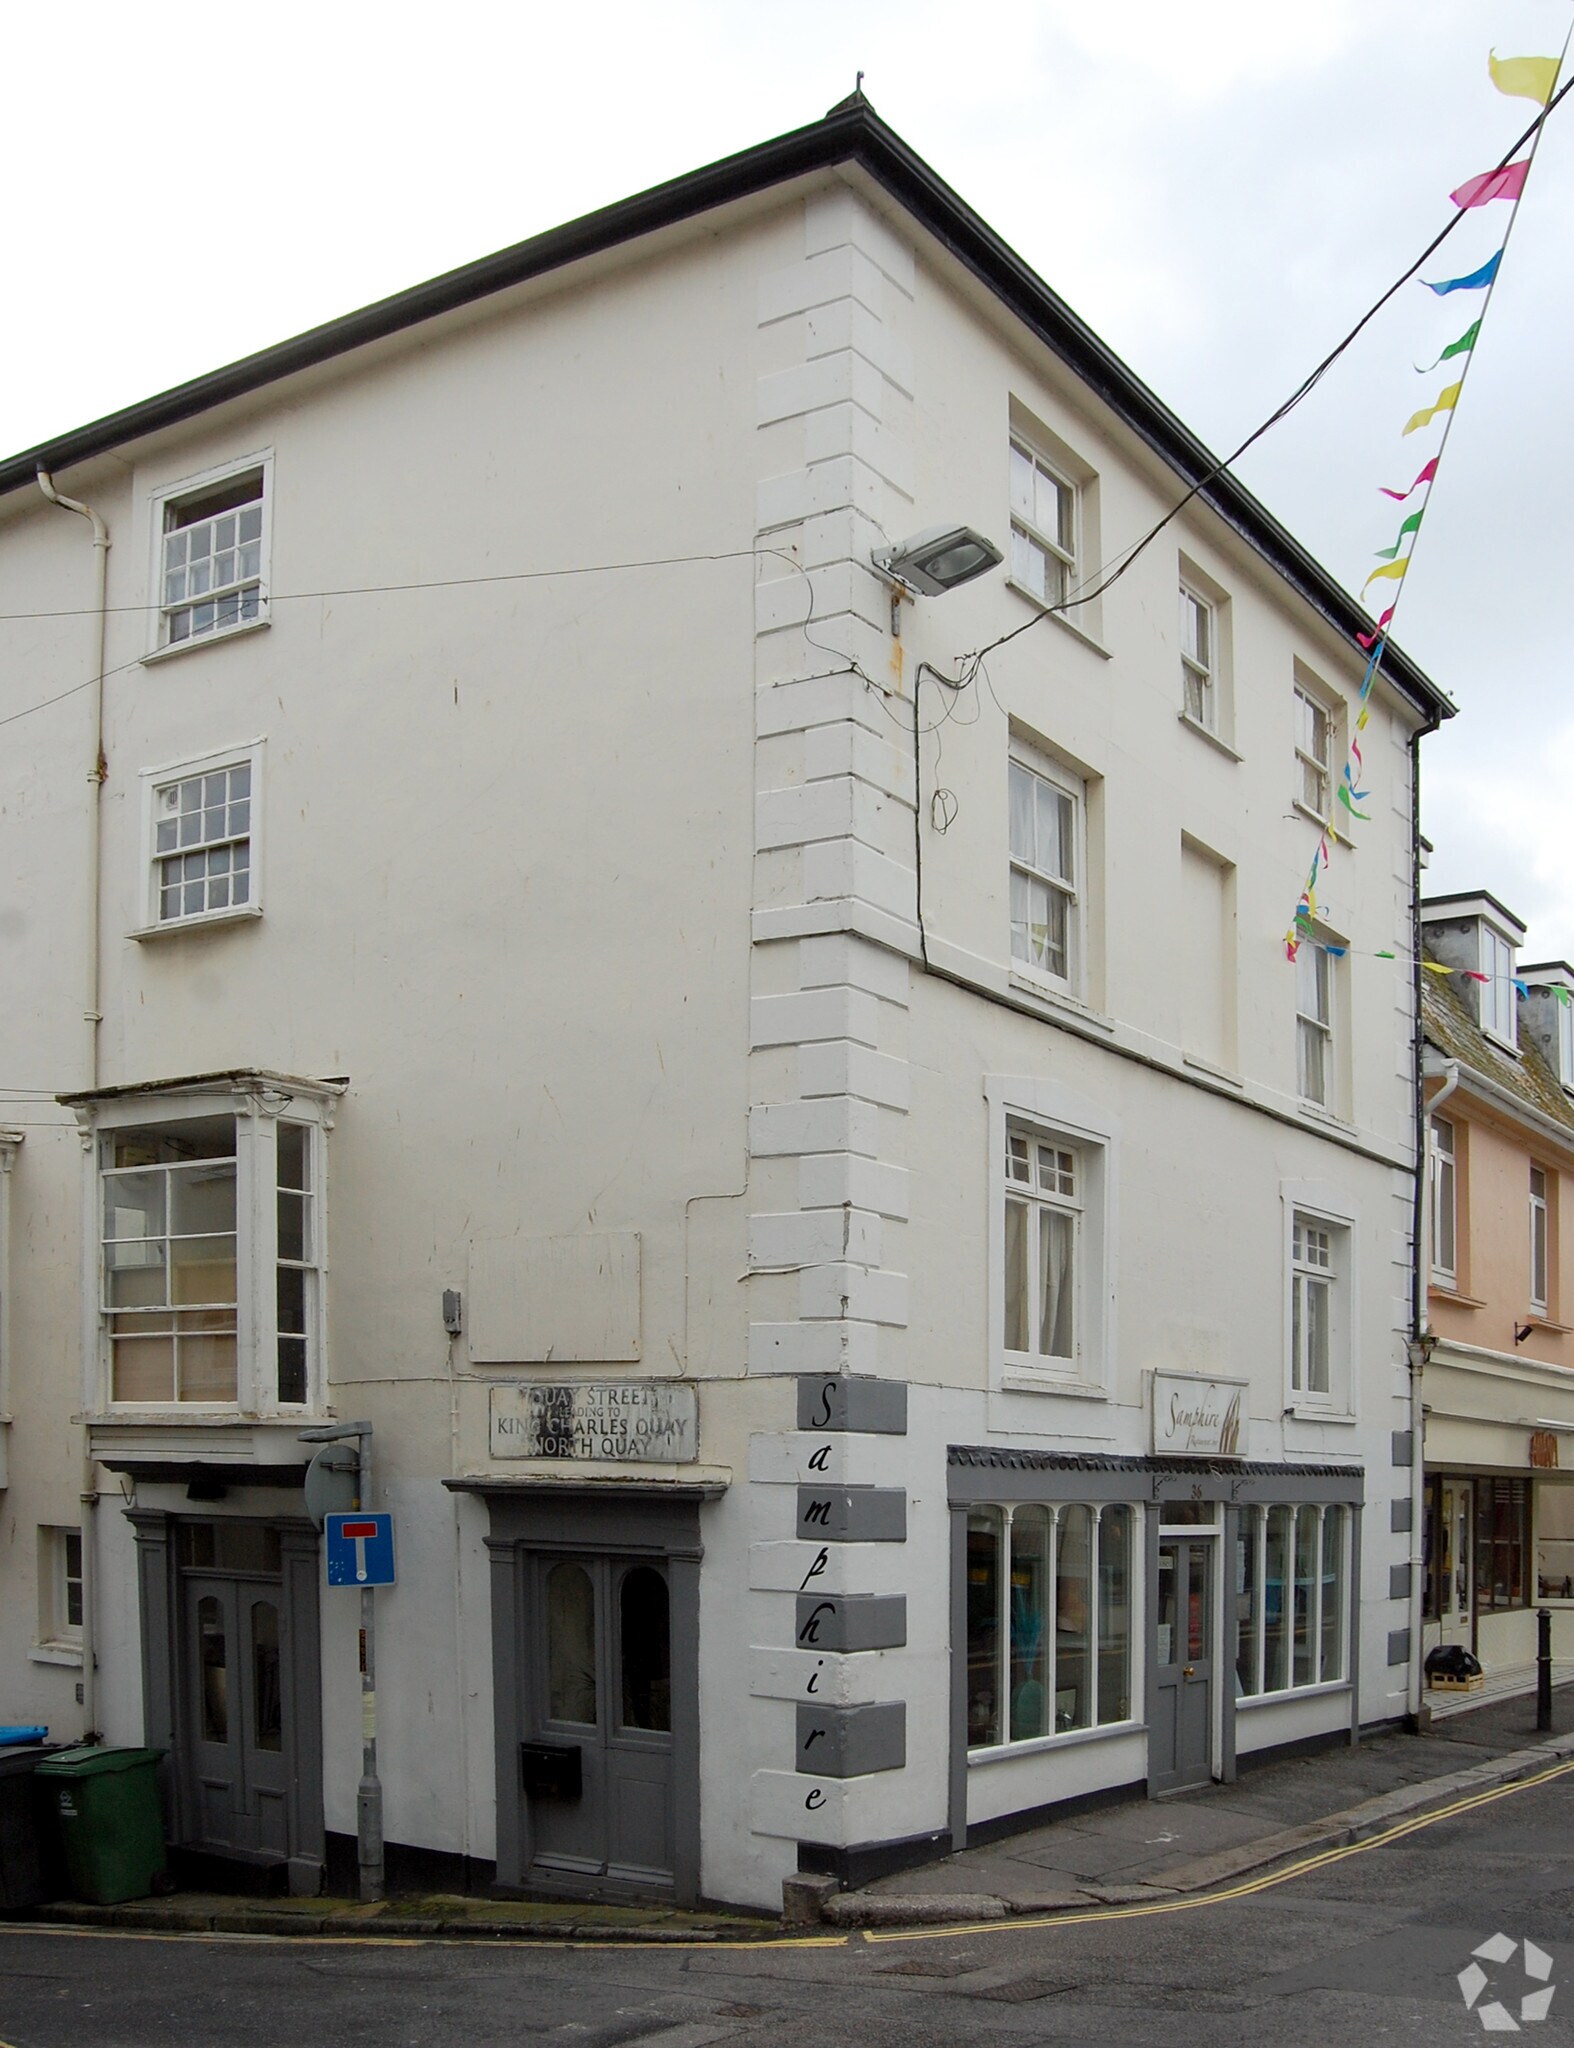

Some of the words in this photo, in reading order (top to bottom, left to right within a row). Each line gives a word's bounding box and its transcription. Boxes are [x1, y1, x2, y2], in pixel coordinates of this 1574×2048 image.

[531, 1387, 578, 1405] QUAY
[587, 1388, 650, 1405] STREET
[558, 1406, 604, 1417] LEADING
[608, 1407, 621, 1417] TO
[1165, 1384, 1220, 1449] Samphire
[498, 1418, 541, 1434] KING
[548, 1418, 628, 1435] CHARLES
[636, 1419, 688, 1436] QUAY
[533, 1436, 593, 1455] NORTH
[601, 1437, 650, 1456] QUAY
[799, 1382, 836, 1811] Samphire
